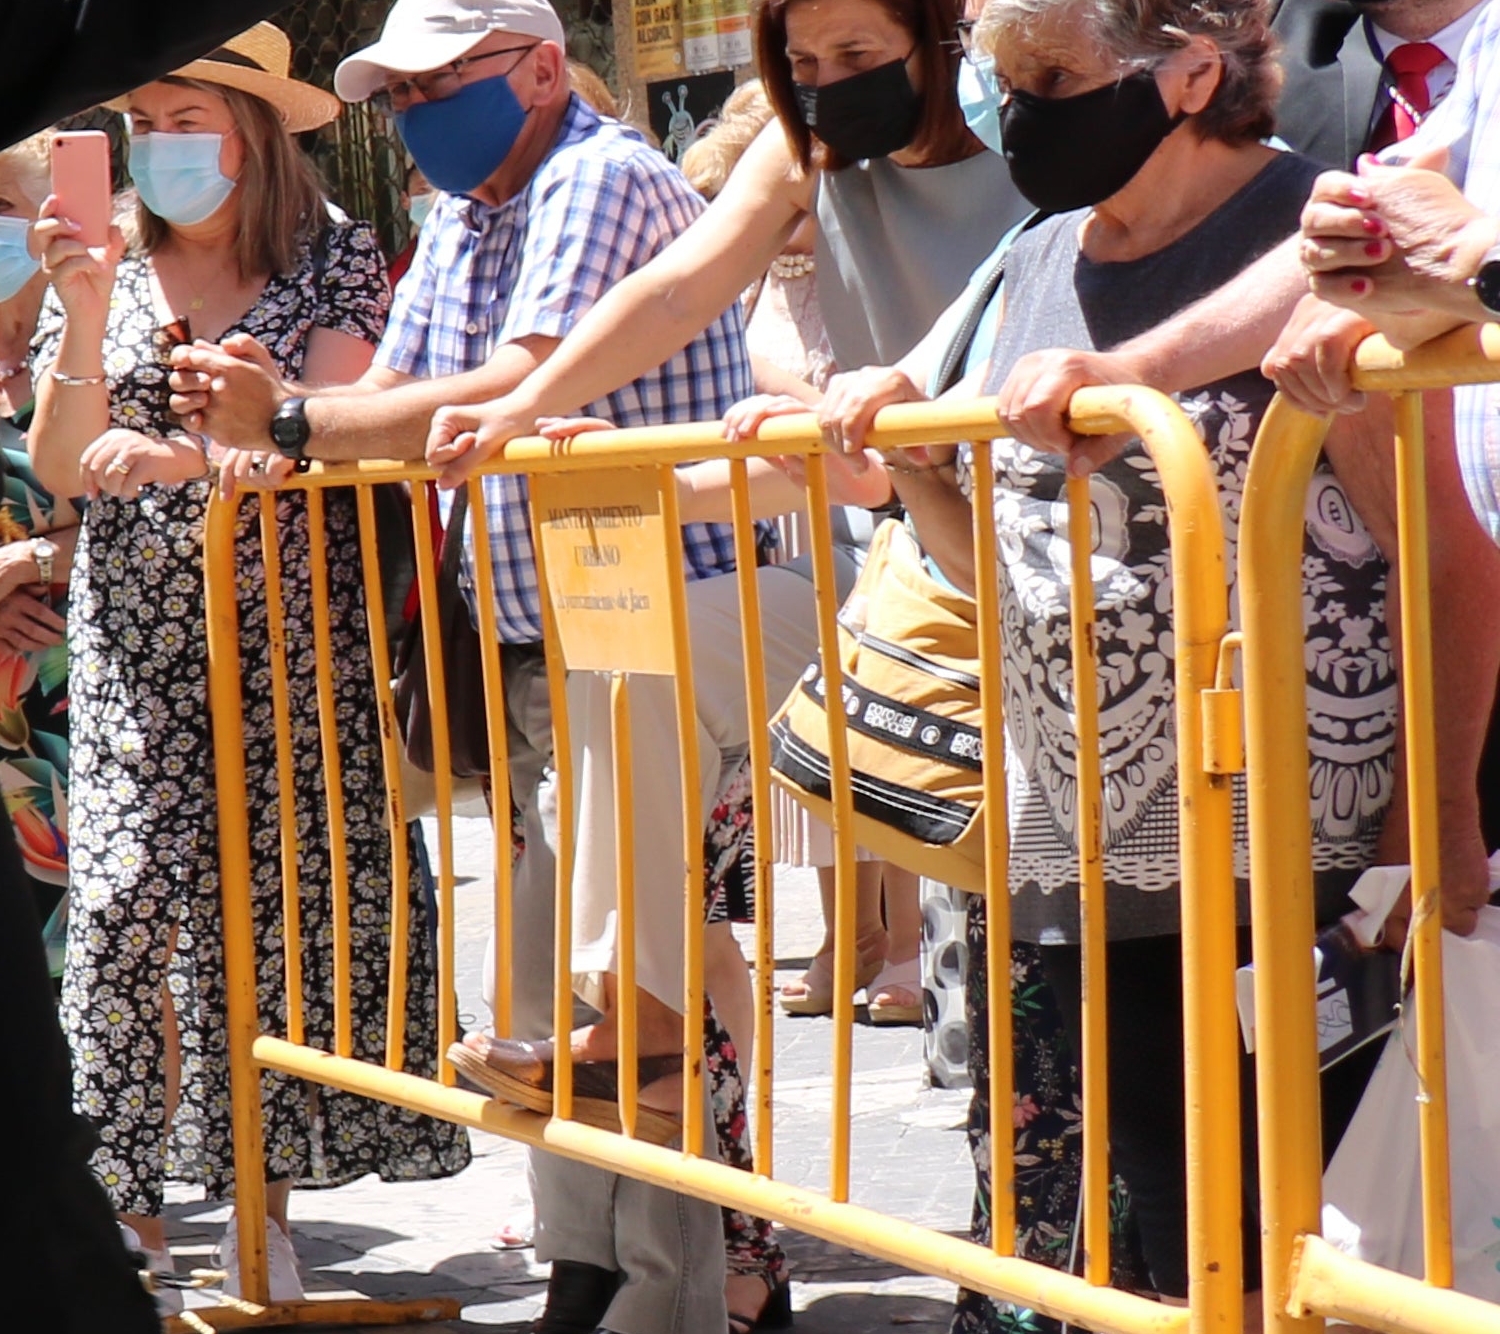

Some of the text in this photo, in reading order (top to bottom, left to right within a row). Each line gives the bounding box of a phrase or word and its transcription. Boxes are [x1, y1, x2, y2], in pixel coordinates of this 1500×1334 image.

[547, 504, 644, 530] MANTENIMIENTO
[574, 544, 621, 568] URBANO
[867, 701, 918, 728] coronel
